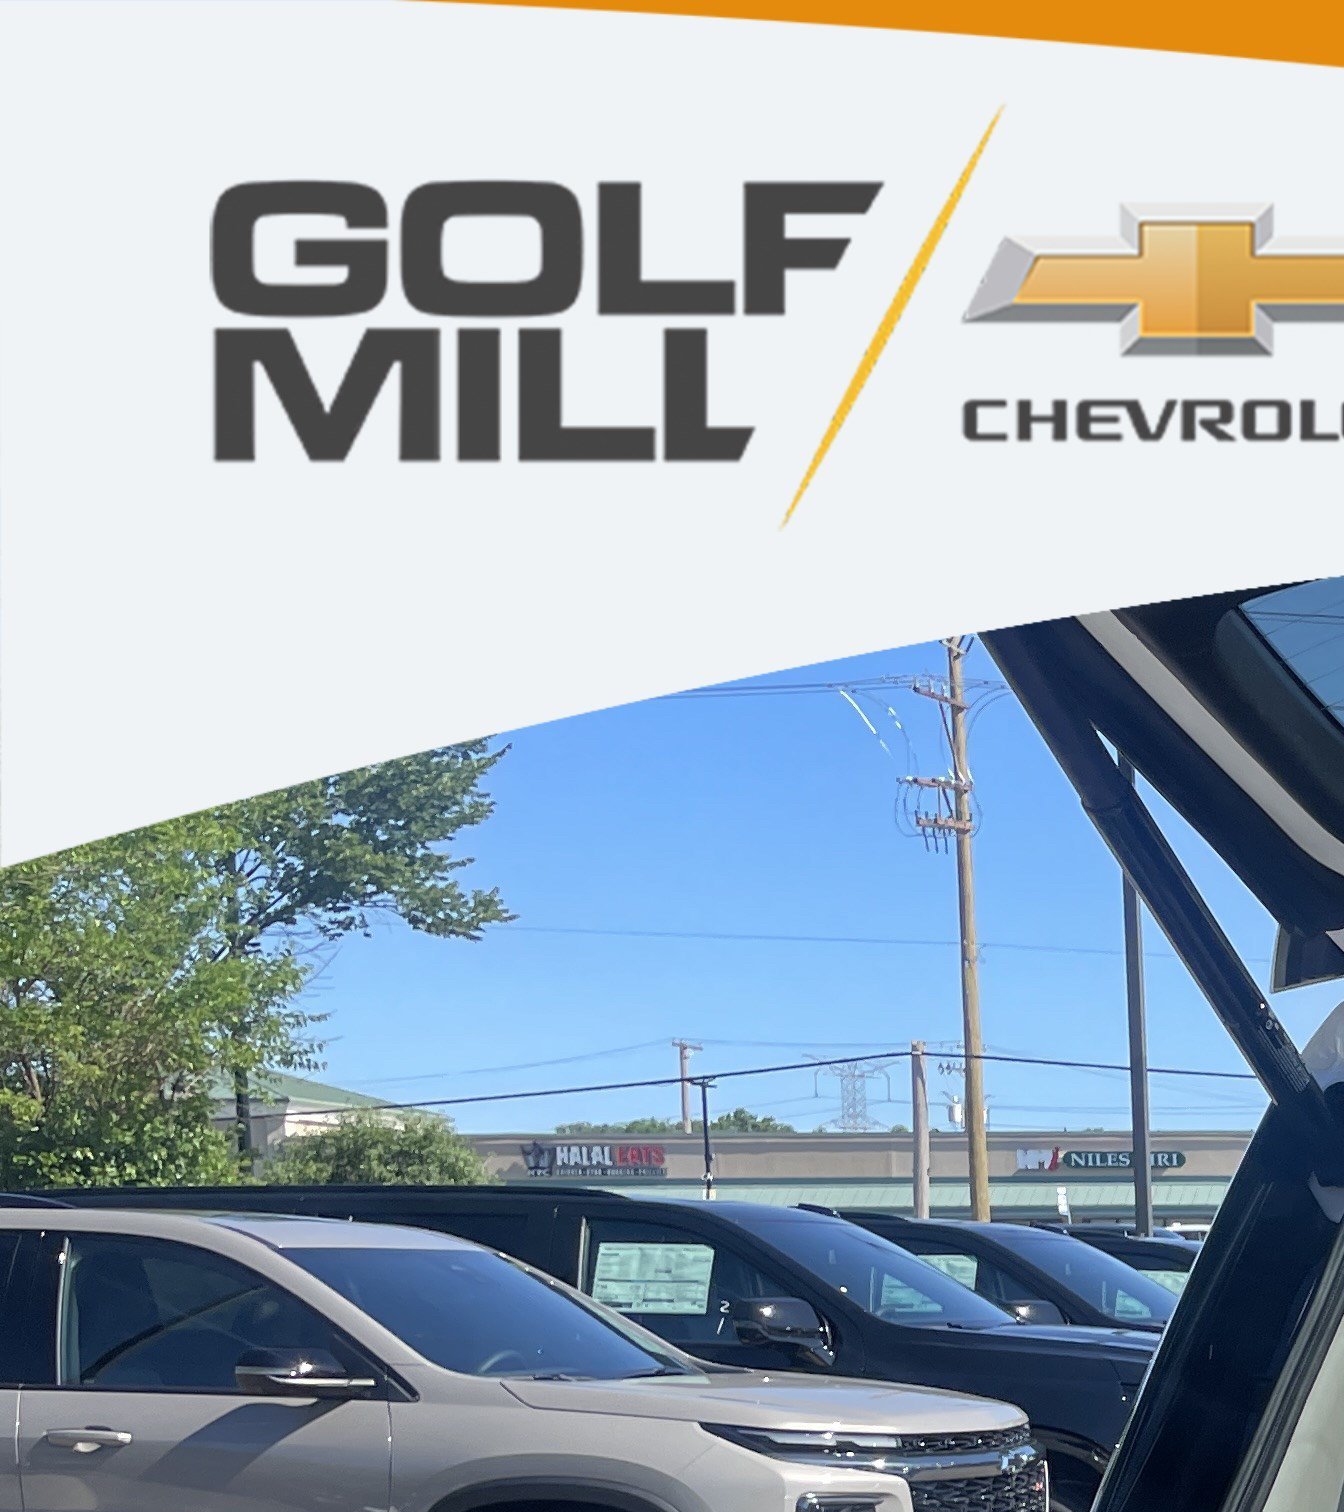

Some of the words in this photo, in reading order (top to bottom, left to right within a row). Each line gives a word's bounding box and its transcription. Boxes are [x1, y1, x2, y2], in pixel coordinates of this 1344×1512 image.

[556, 1146, 613, 1167] HALAL
[617, 1145, 665, 1166] EATS
[1071, 1152, 1131, 1167] NILES
